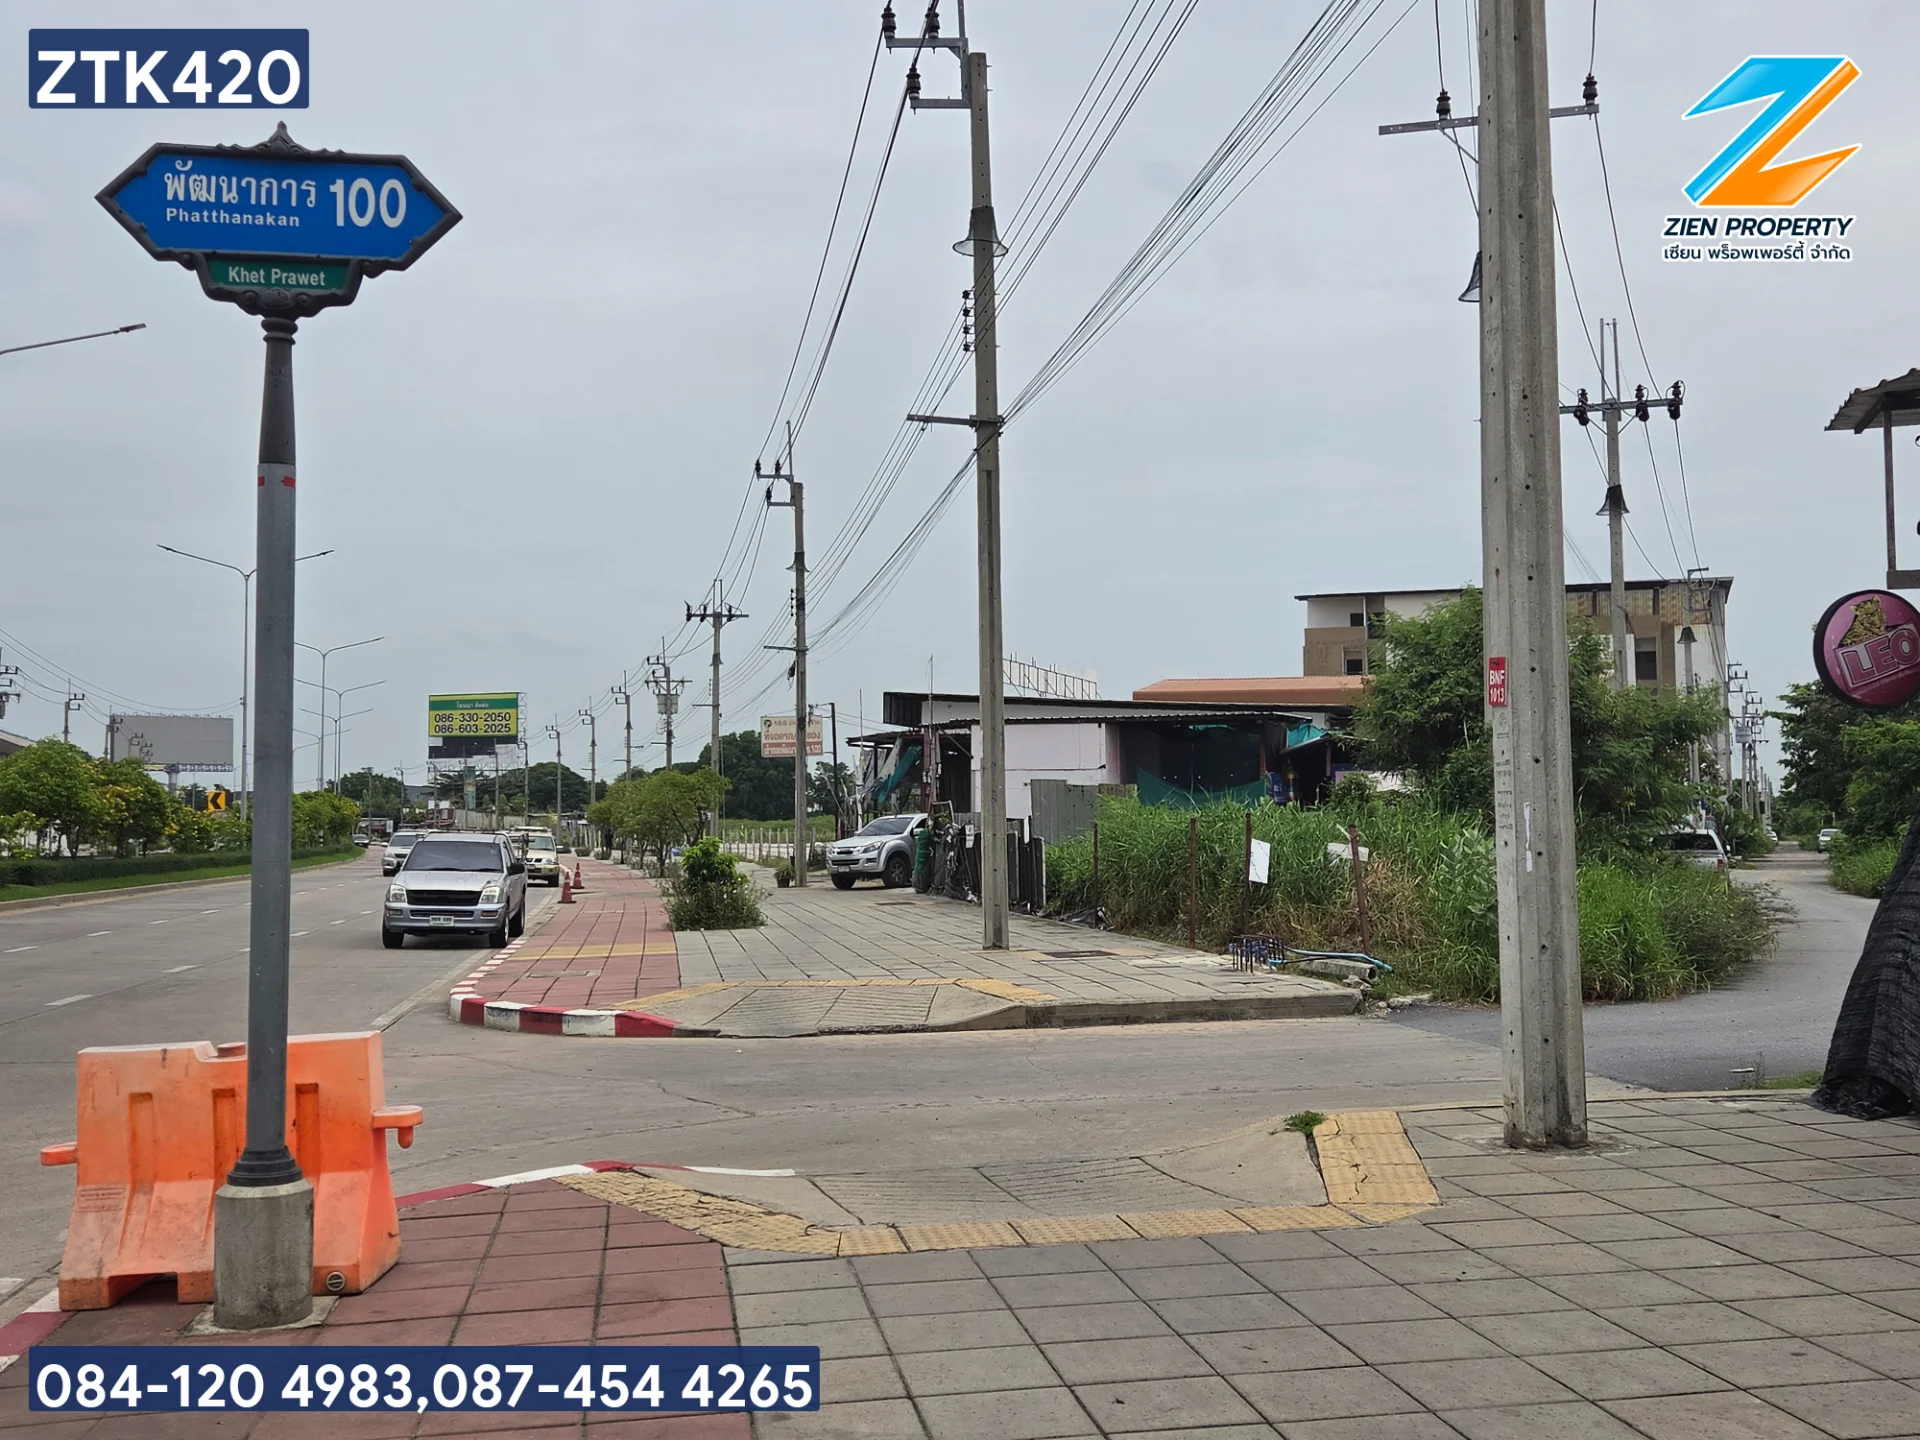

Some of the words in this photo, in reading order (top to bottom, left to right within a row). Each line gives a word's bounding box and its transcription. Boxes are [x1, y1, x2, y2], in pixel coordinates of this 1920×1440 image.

[163, 159, 317, 209] พัฒนาการ
[329, 177, 407, 228] 100
[166, 207, 300, 228] Phatthanakan
[227, 265, 265, 284] Khet
[271, 267, 327, 287] Prawet
[1841, 627, 1920, 686] LEO
[1489, 669, 1505, 686] BNF
[1489, 687, 1505, 703] 1013
[434, 712, 511, 723] 086-330-2050
[434, 723, 511, 733] 086-603-2025
